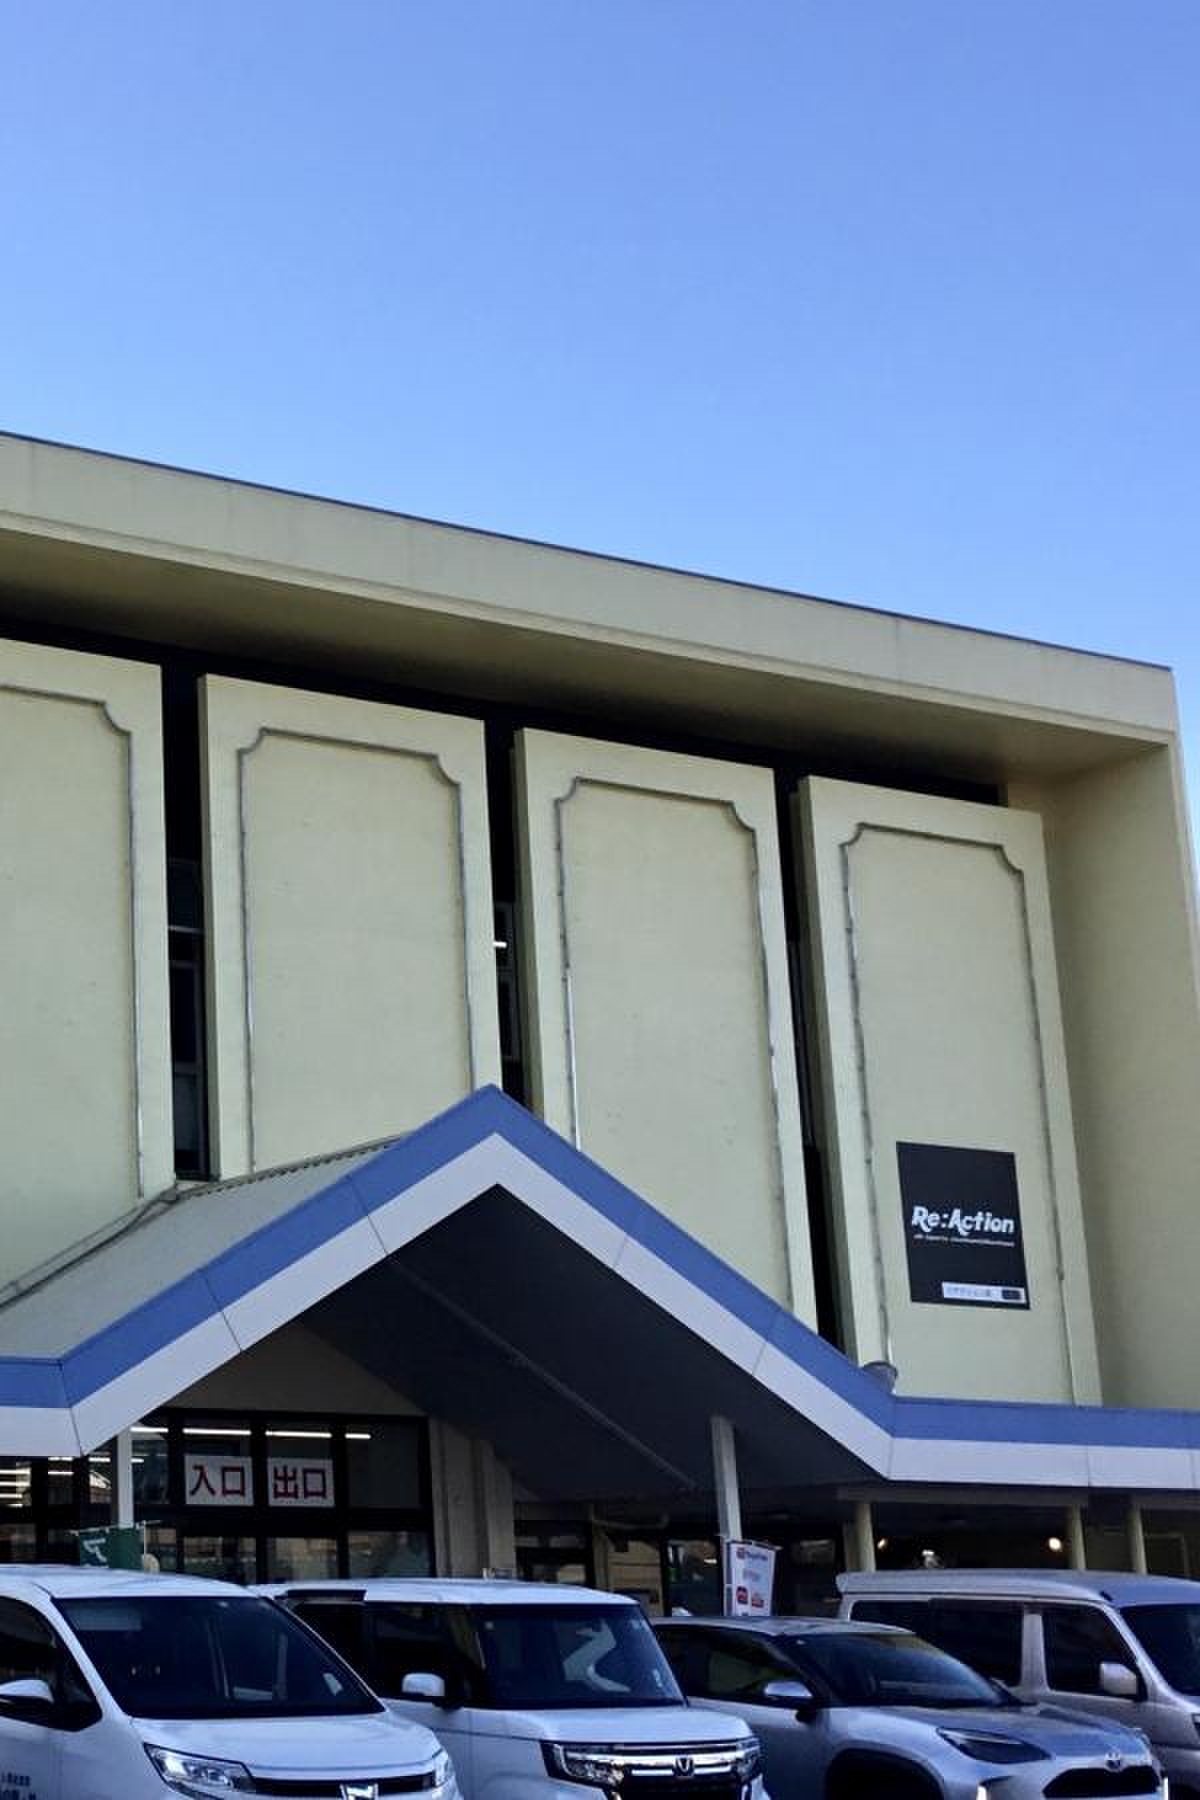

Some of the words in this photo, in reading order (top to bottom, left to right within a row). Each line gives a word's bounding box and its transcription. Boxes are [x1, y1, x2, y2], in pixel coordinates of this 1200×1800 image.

[912, 1205, 1015, 1237] Re:Action
[190, 1464, 246, 1497] 入口
[273, 1465, 327, 1499] 出口
